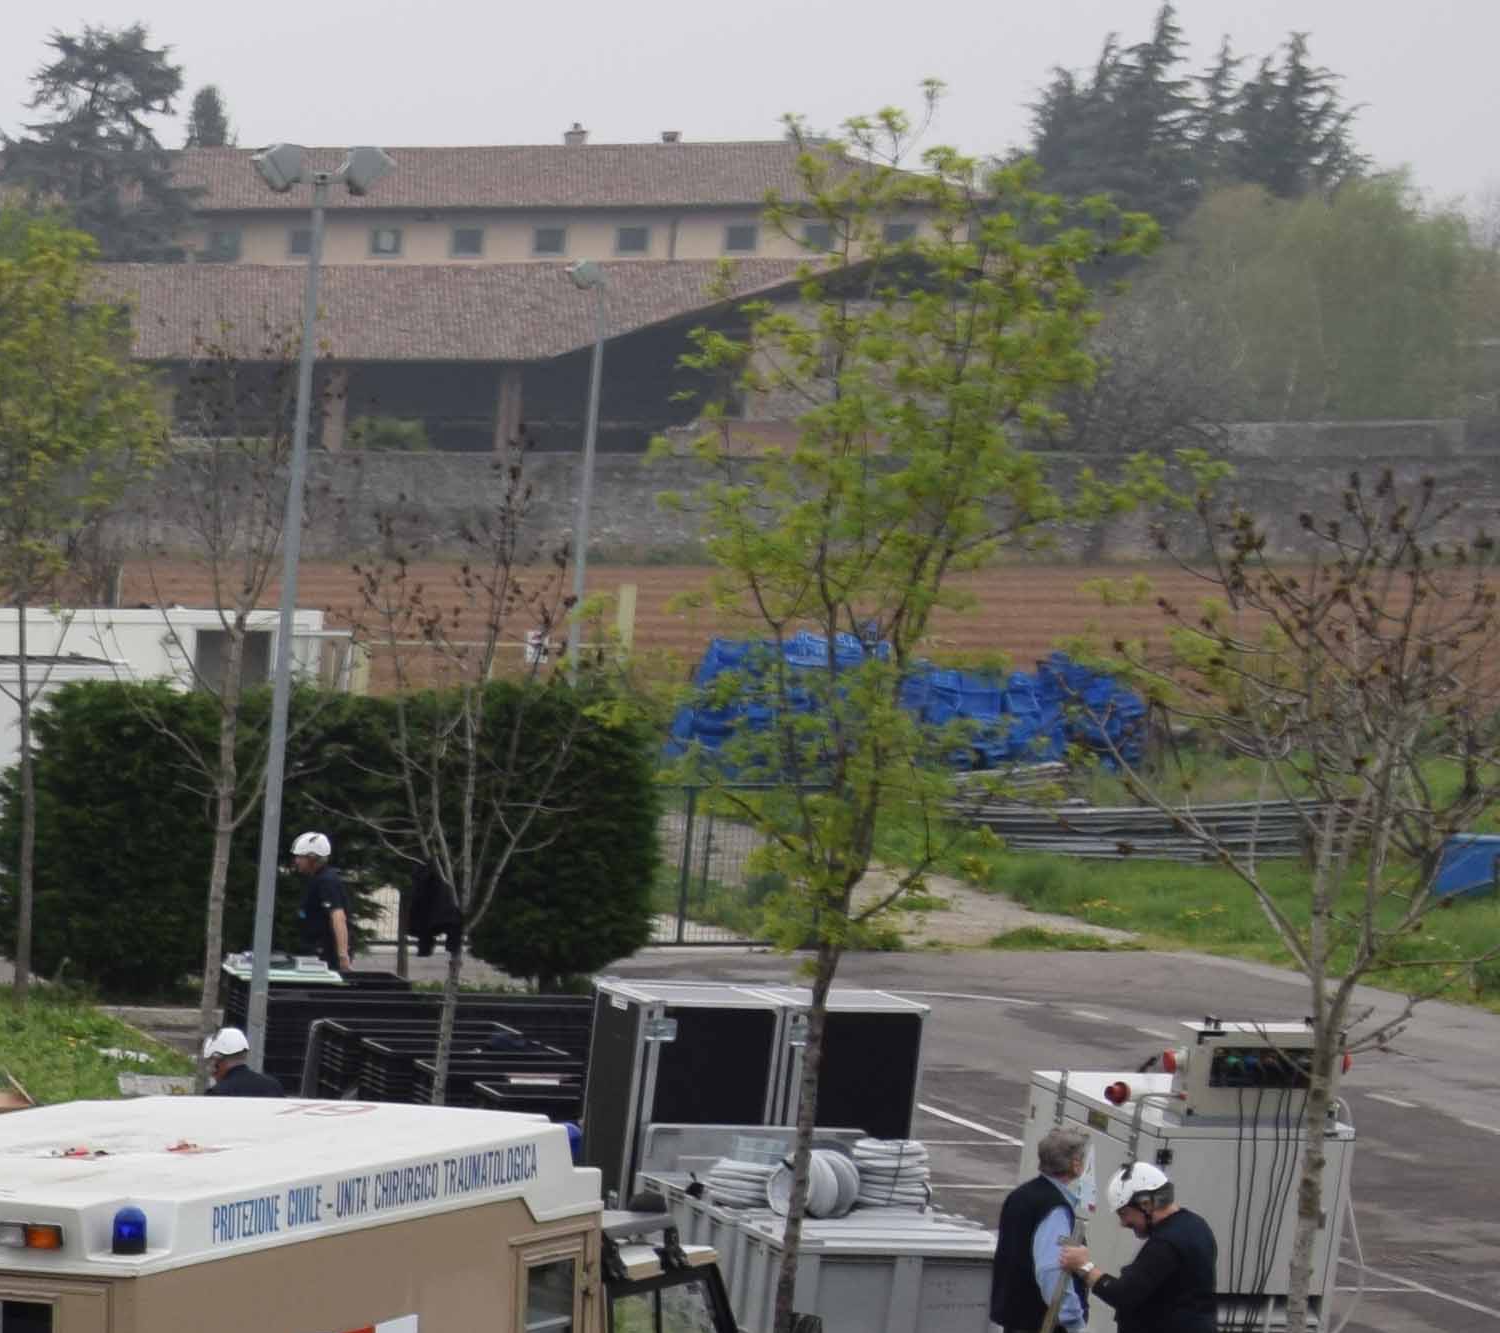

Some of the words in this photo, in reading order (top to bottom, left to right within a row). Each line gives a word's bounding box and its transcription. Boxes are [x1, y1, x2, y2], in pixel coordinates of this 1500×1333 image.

[213, 1195, 281, 1244] PROTEZIONE
[288, 1185, 323, 1227] CIVILE
[336, 1176, 371, 1219] UNITA'
[374, 1162, 440, 1212] CHIRURGICO
[443, 1143, 538, 1196] TRAUMATOLOGICA
